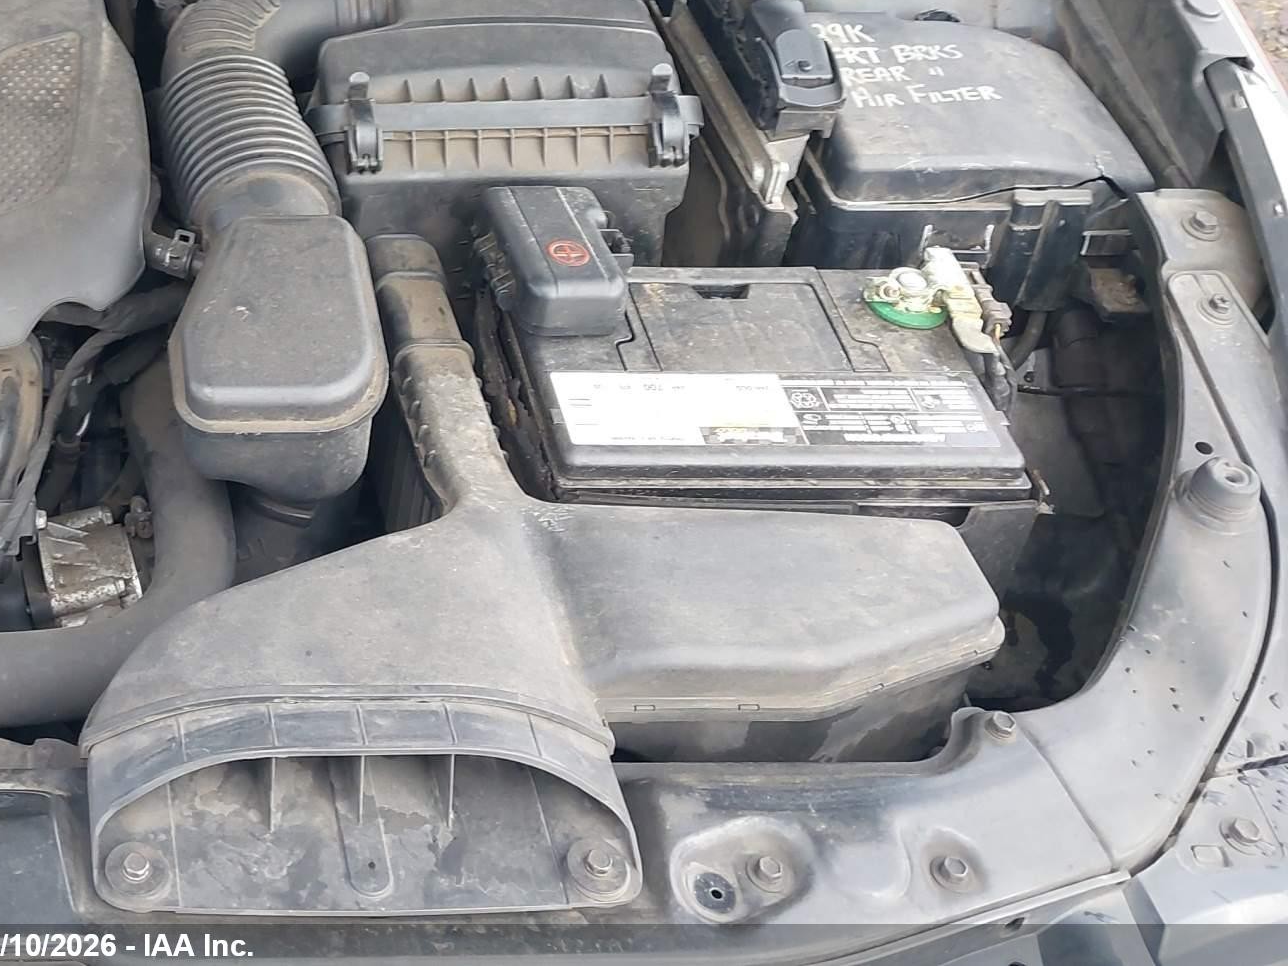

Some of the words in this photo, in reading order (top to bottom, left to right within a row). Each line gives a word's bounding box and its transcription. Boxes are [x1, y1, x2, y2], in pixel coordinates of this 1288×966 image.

[891, 44, 963, 63] BRKS
[839, 65, 913, 87] REAR
[850, 88, 905, 107] AIR
